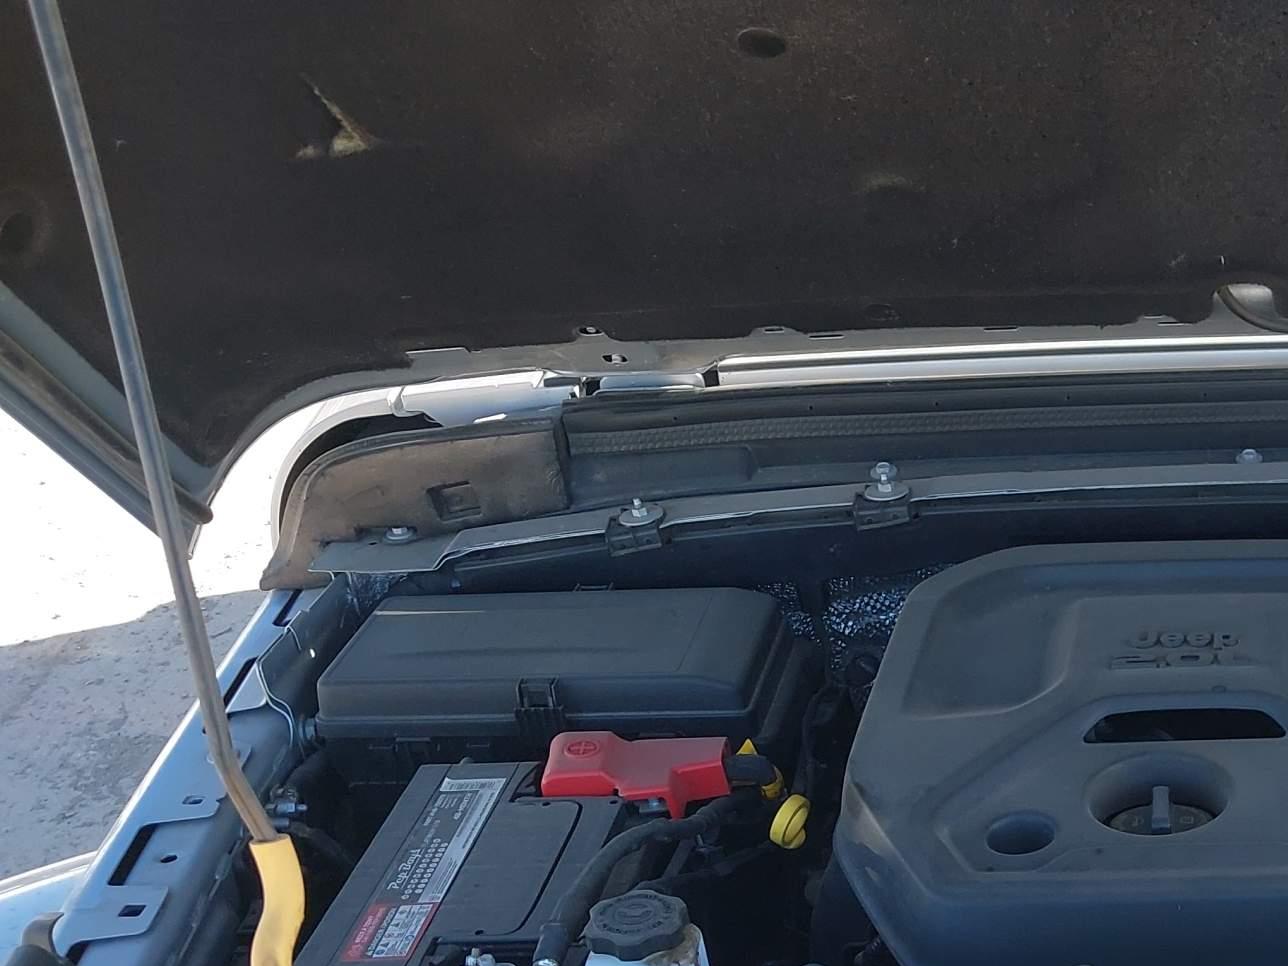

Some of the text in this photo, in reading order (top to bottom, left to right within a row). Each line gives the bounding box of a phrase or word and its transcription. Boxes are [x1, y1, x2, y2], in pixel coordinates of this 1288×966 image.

[1125, 629, 1240, 650] Jeep
[1108, 651, 1256, 669] 2.0L
[386, 871, 409, 890] Pep
